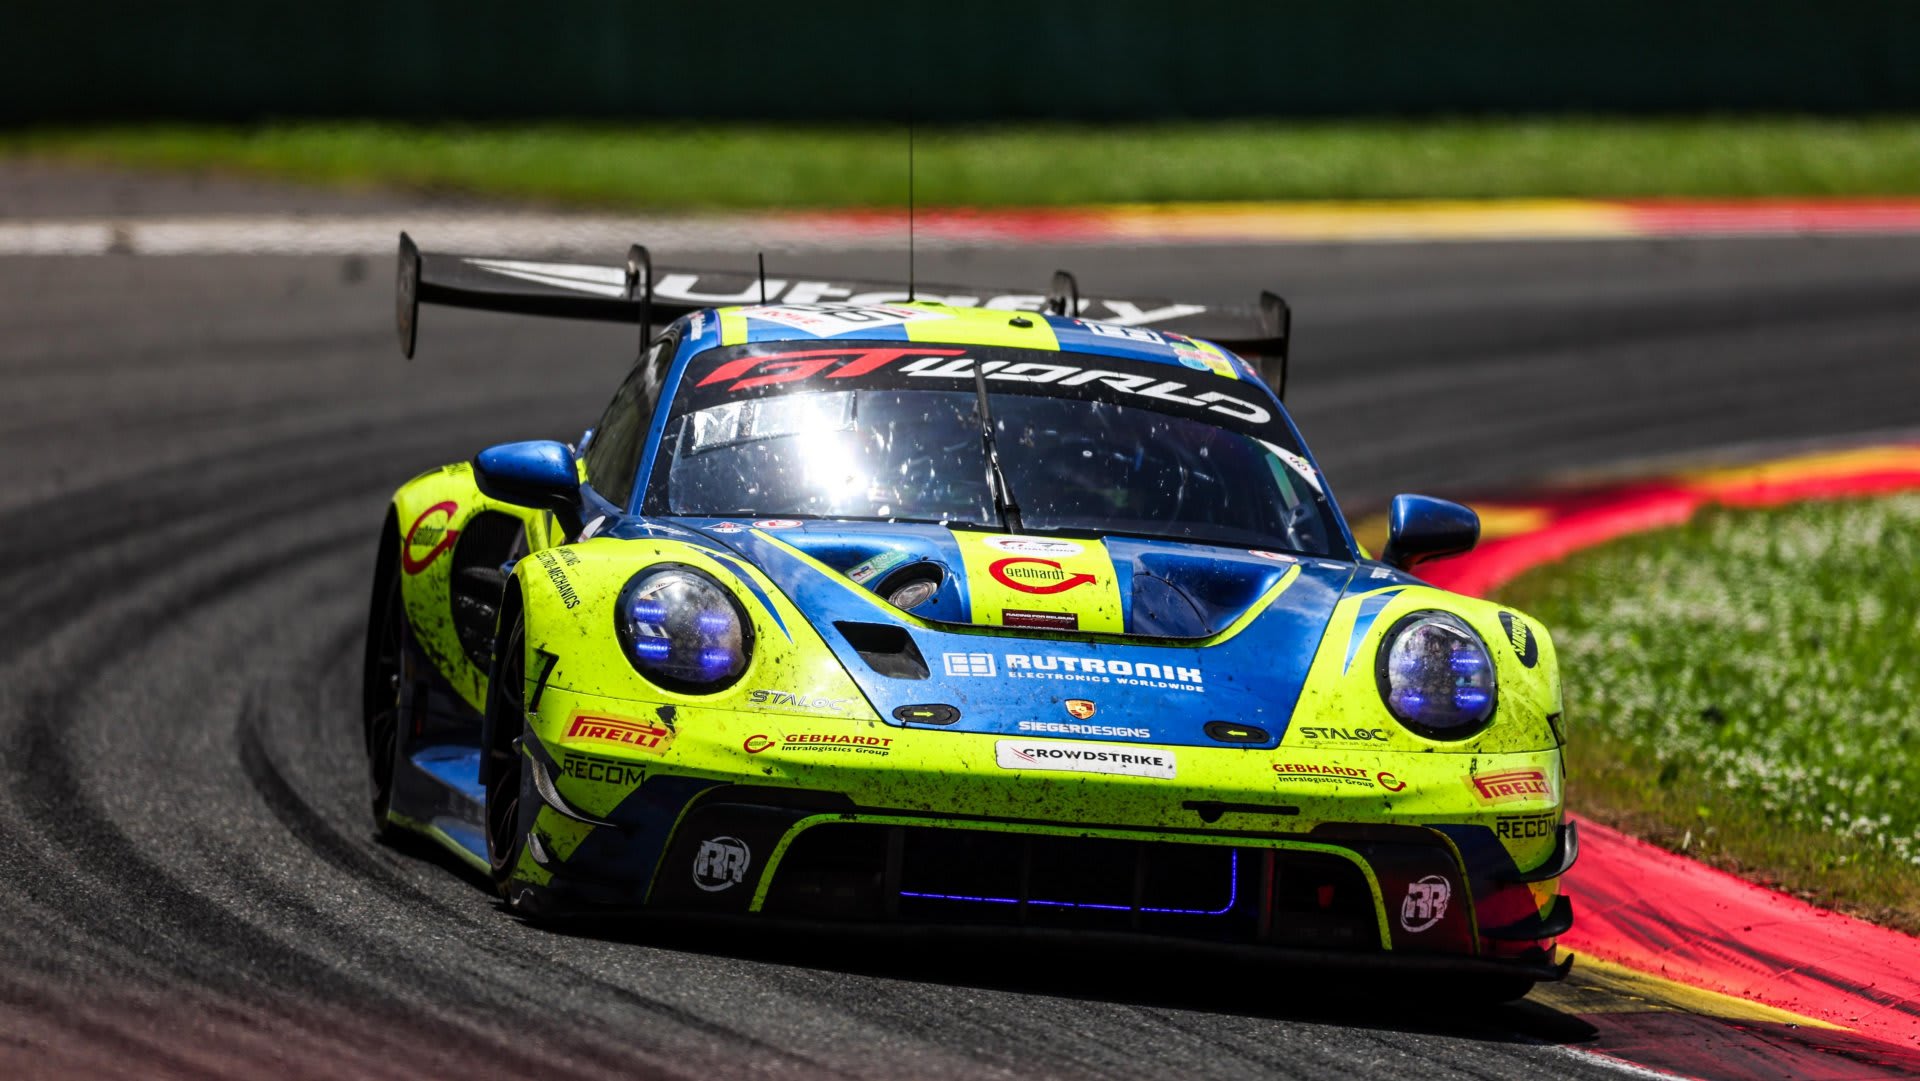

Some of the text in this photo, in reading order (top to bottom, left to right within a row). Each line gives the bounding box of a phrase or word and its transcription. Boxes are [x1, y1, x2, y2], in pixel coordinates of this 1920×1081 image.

[696, 348, 967, 391] GT
[899, 357, 1271, 424] WORLD
[1006, 567, 1064, 581] gebhardt
[1009, 671, 1205, 693] ELECTRONICS WORLDWIDE
[568, 715, 667, 748] PIRELLI
[1018, 721, 1151, 738] SIEGERDESIGNS
[1299, 726, 1389, 742] STALOC
[785, 734, 893, 746] GEBHARDT
[781, 745, 890, 757] Intralogistics Group
[1023, 748, 1164, 767] CROWDSTRIKE
[562, 757, 648, 786] RECOM
[1272, 763, 1368, 778] GEBHARDT
[1279, 776, 1343, 784] Intralogistics
[1345, 779, 1375, 789] Group
[1472, 771, 1550, 799] PIRELLI
[1496, 817, 1556, 839] RECOM
[697, 840, 744, 883] RR
[1405, 882, 1447, 919] RR
